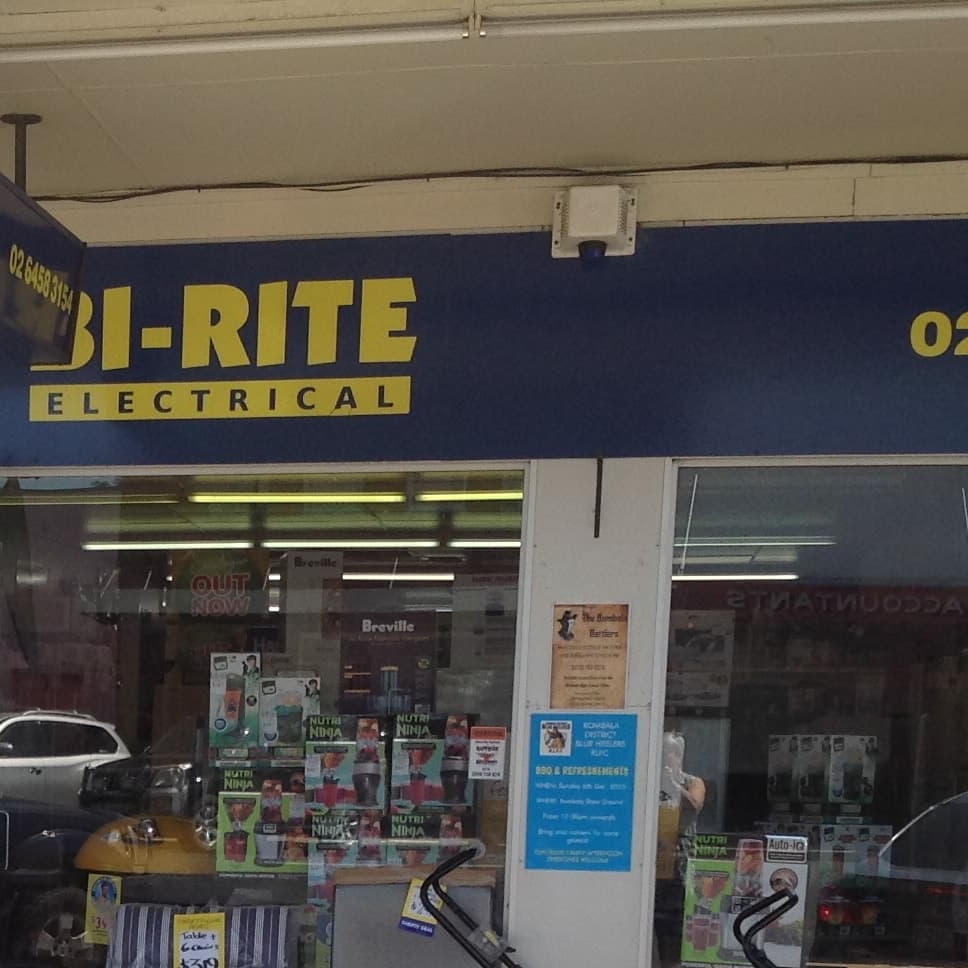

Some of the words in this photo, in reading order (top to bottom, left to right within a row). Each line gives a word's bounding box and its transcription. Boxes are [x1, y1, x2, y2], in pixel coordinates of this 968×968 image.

[9, 244, 25, 280] 02
[47, 386, 394, 416] ELECTRICAL
[294, 556, 337, 569] Breville
[191, 573, 250, 597] OUT
[191, 597, 250, 617] NOW
[362, 618, 416, 633] Breville
[310, 716, 342, 725] NUTRI
[397, 713, 430, 723] NUTRI
[310, 726, 343, 739] NINJA
[397, 724, 431, 739] NINJA
[224, 769, 253, 778] NUTRI
[224, 778, 254, 791] NINJA
[392, 815, 424, 824] NUTRI
[312, 824, 345, 838] NINJA
[392, 824, 425, 837] NINJA
[695, 835, 728, 844] NUTRI
[695, 845, 728, 858] NINJA
